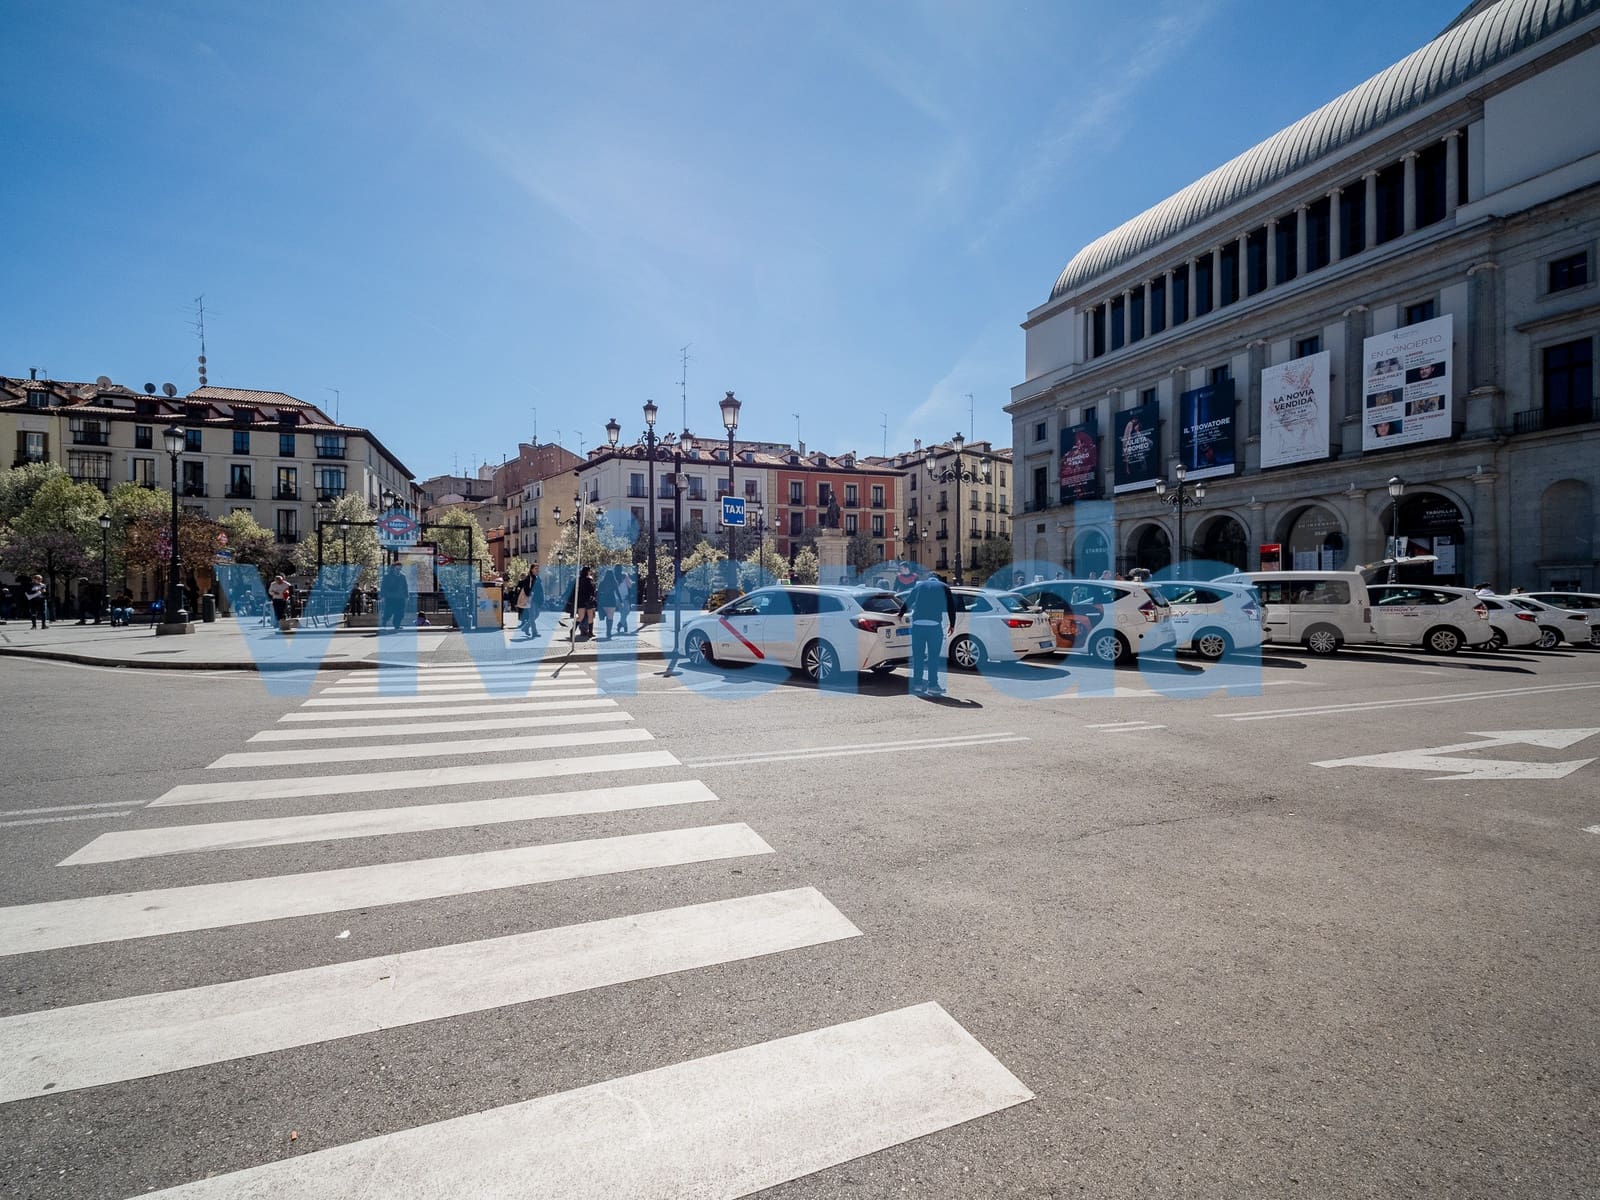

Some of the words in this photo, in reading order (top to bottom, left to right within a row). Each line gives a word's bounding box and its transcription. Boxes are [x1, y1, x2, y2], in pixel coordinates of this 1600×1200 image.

[1370, 350, 1384, 360] EN
[1385, 335, 1442, 356] CONCIERTO
[1273, 395, 1284, 404] LA
[1286, 388, 1314, 400] NOVIA
[1274, 396, 1313, 411] VENDIDA
[1190, 416, 1231, 433] TROVATORE
[724, 504, 744, 514] TAXI
